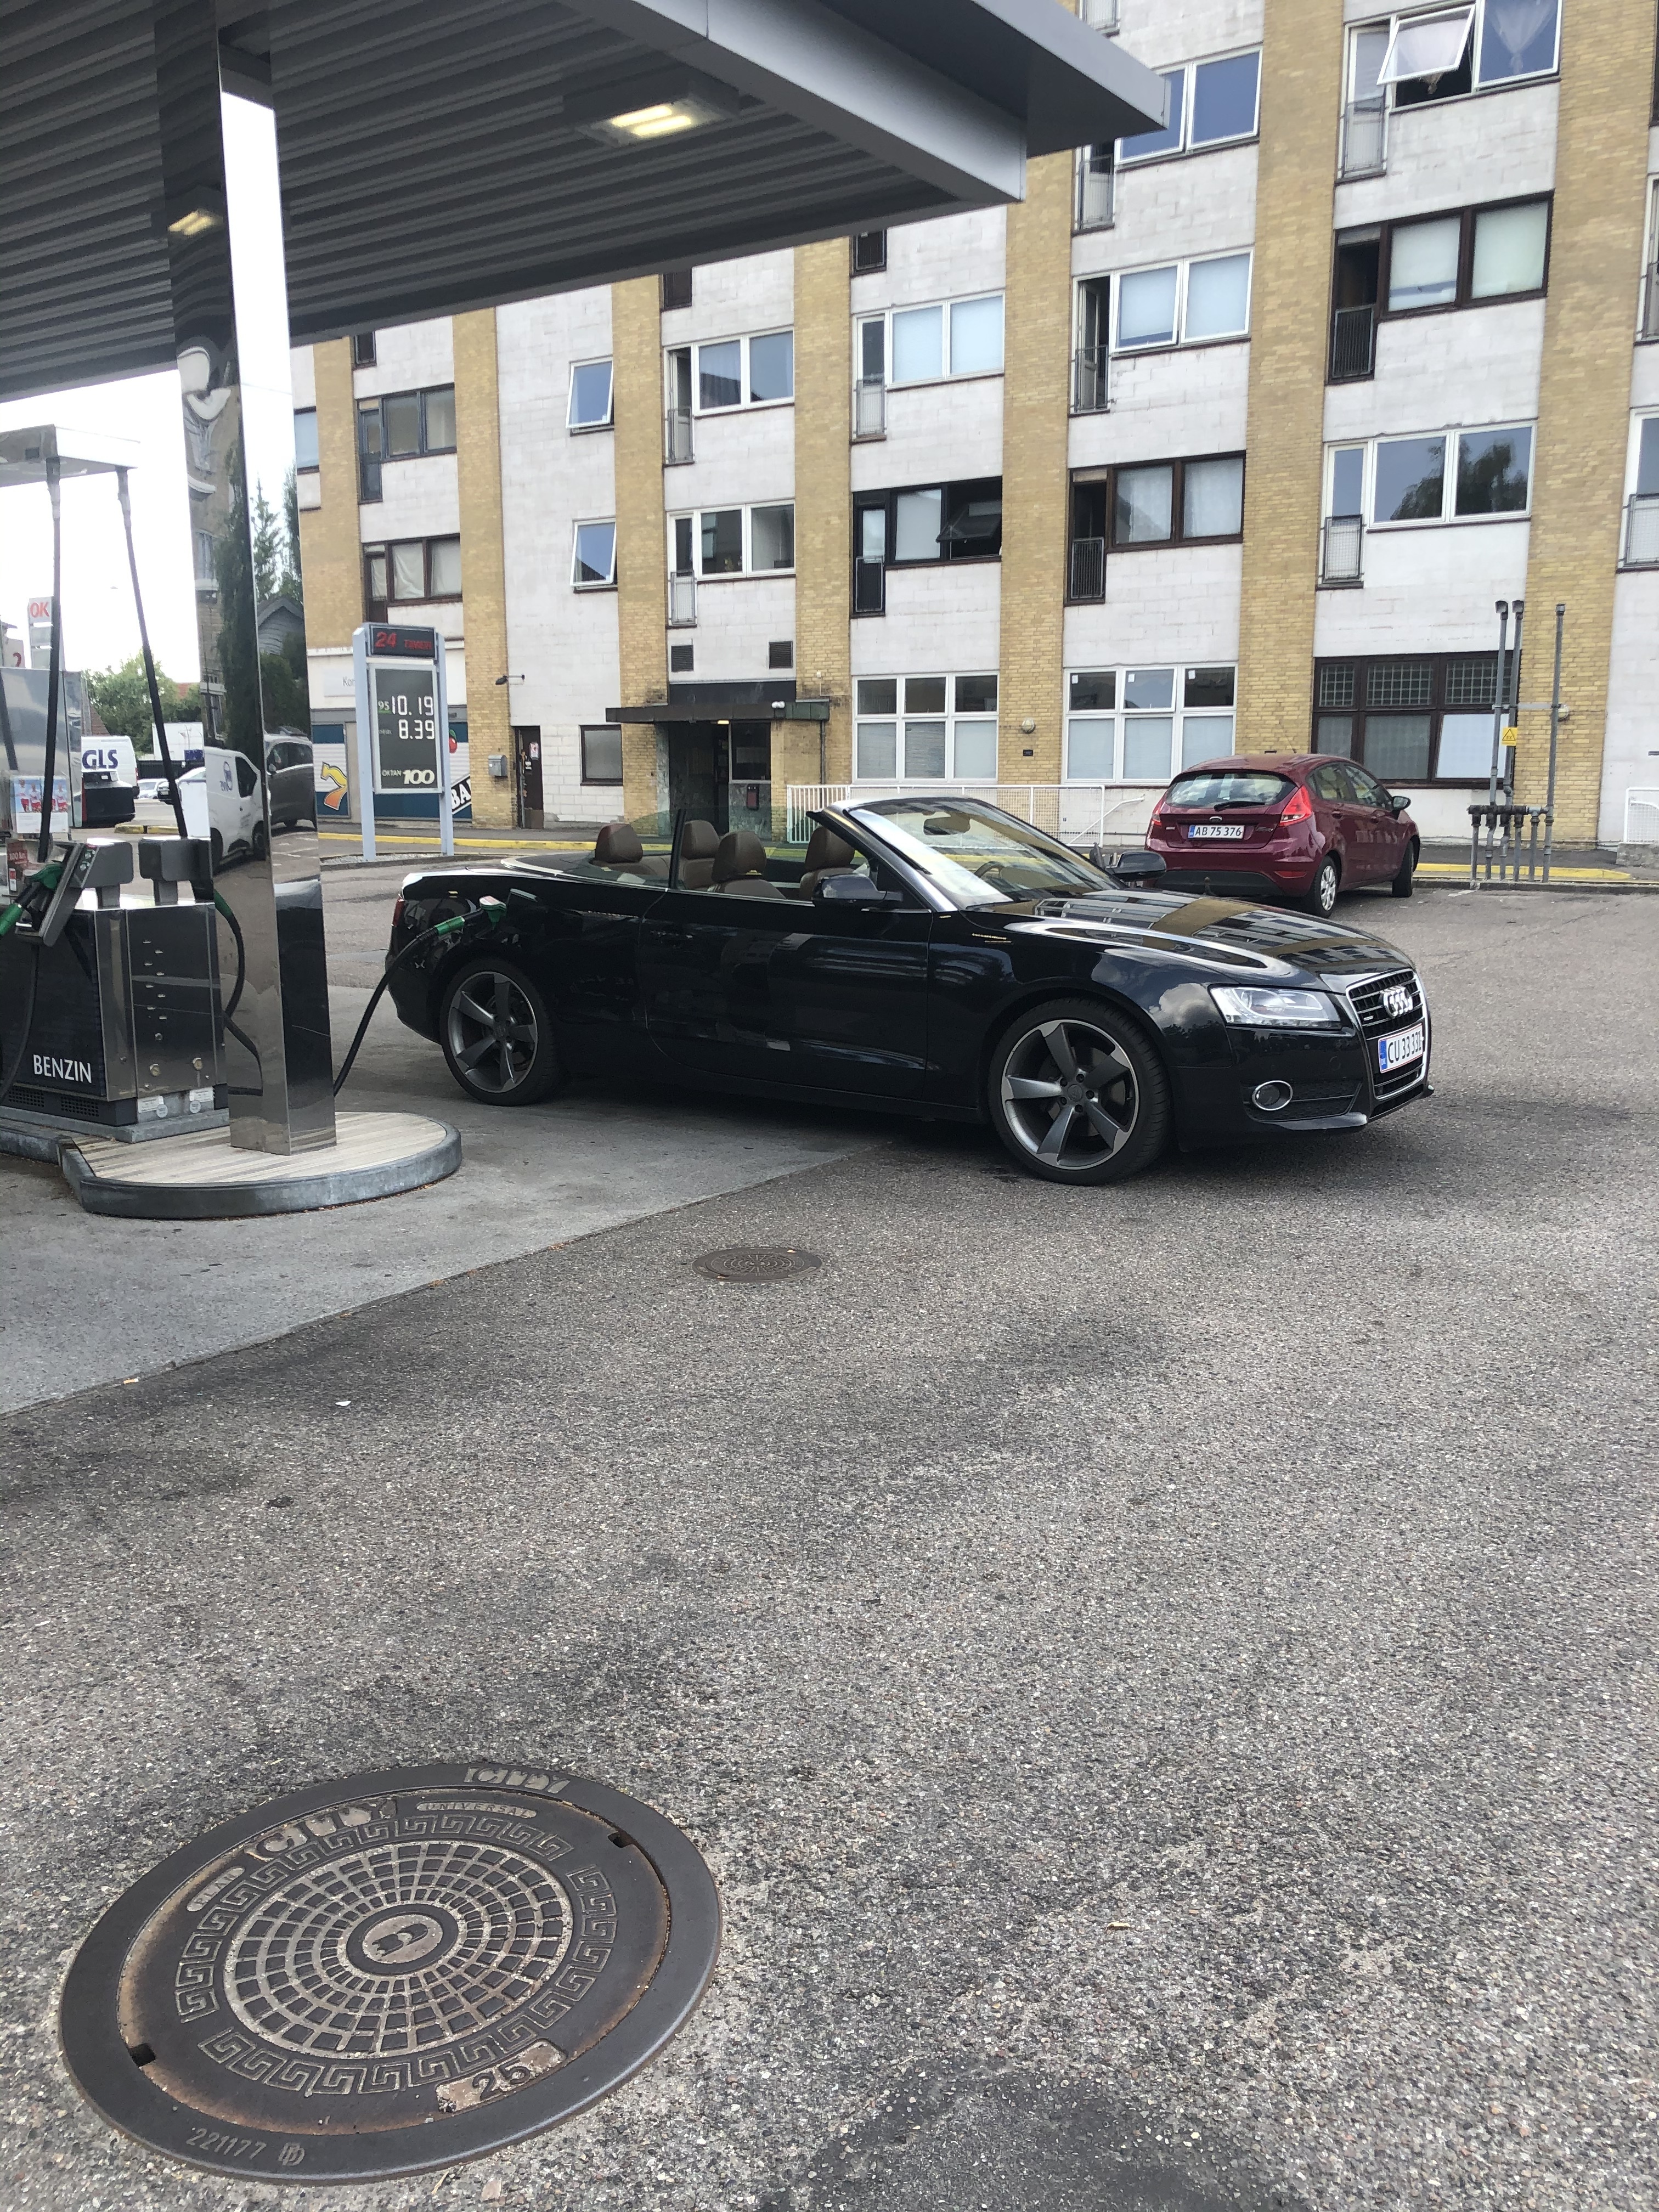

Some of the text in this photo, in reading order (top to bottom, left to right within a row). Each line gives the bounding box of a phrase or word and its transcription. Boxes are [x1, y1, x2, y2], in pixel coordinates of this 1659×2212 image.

[30, 602, 50, 618] OK
[375, 632, 397, 648] 24
[377, 695, 434, 716] 95 10.19
[398, 719, 435, 740] 8.39
[82, 749, 119, 770] GLS
[402, 769, 435, 785] 100
[1195, 827, 1242, 837] AB 75 376
[1387, 1039, 1400, 1064] CU
[1402, 1036, 1410, 1059] 33
[33, 1054, 92, 1084] BENZIN
[473, 1767, 570, 1795] CITY
[256, 1798, 388, 1857] CITY
[425, 1802, 528, 1818] UNIVERSAL
[472, 2058, 531, 2101] 25
[185, 2127, 268, 2160] 221177
